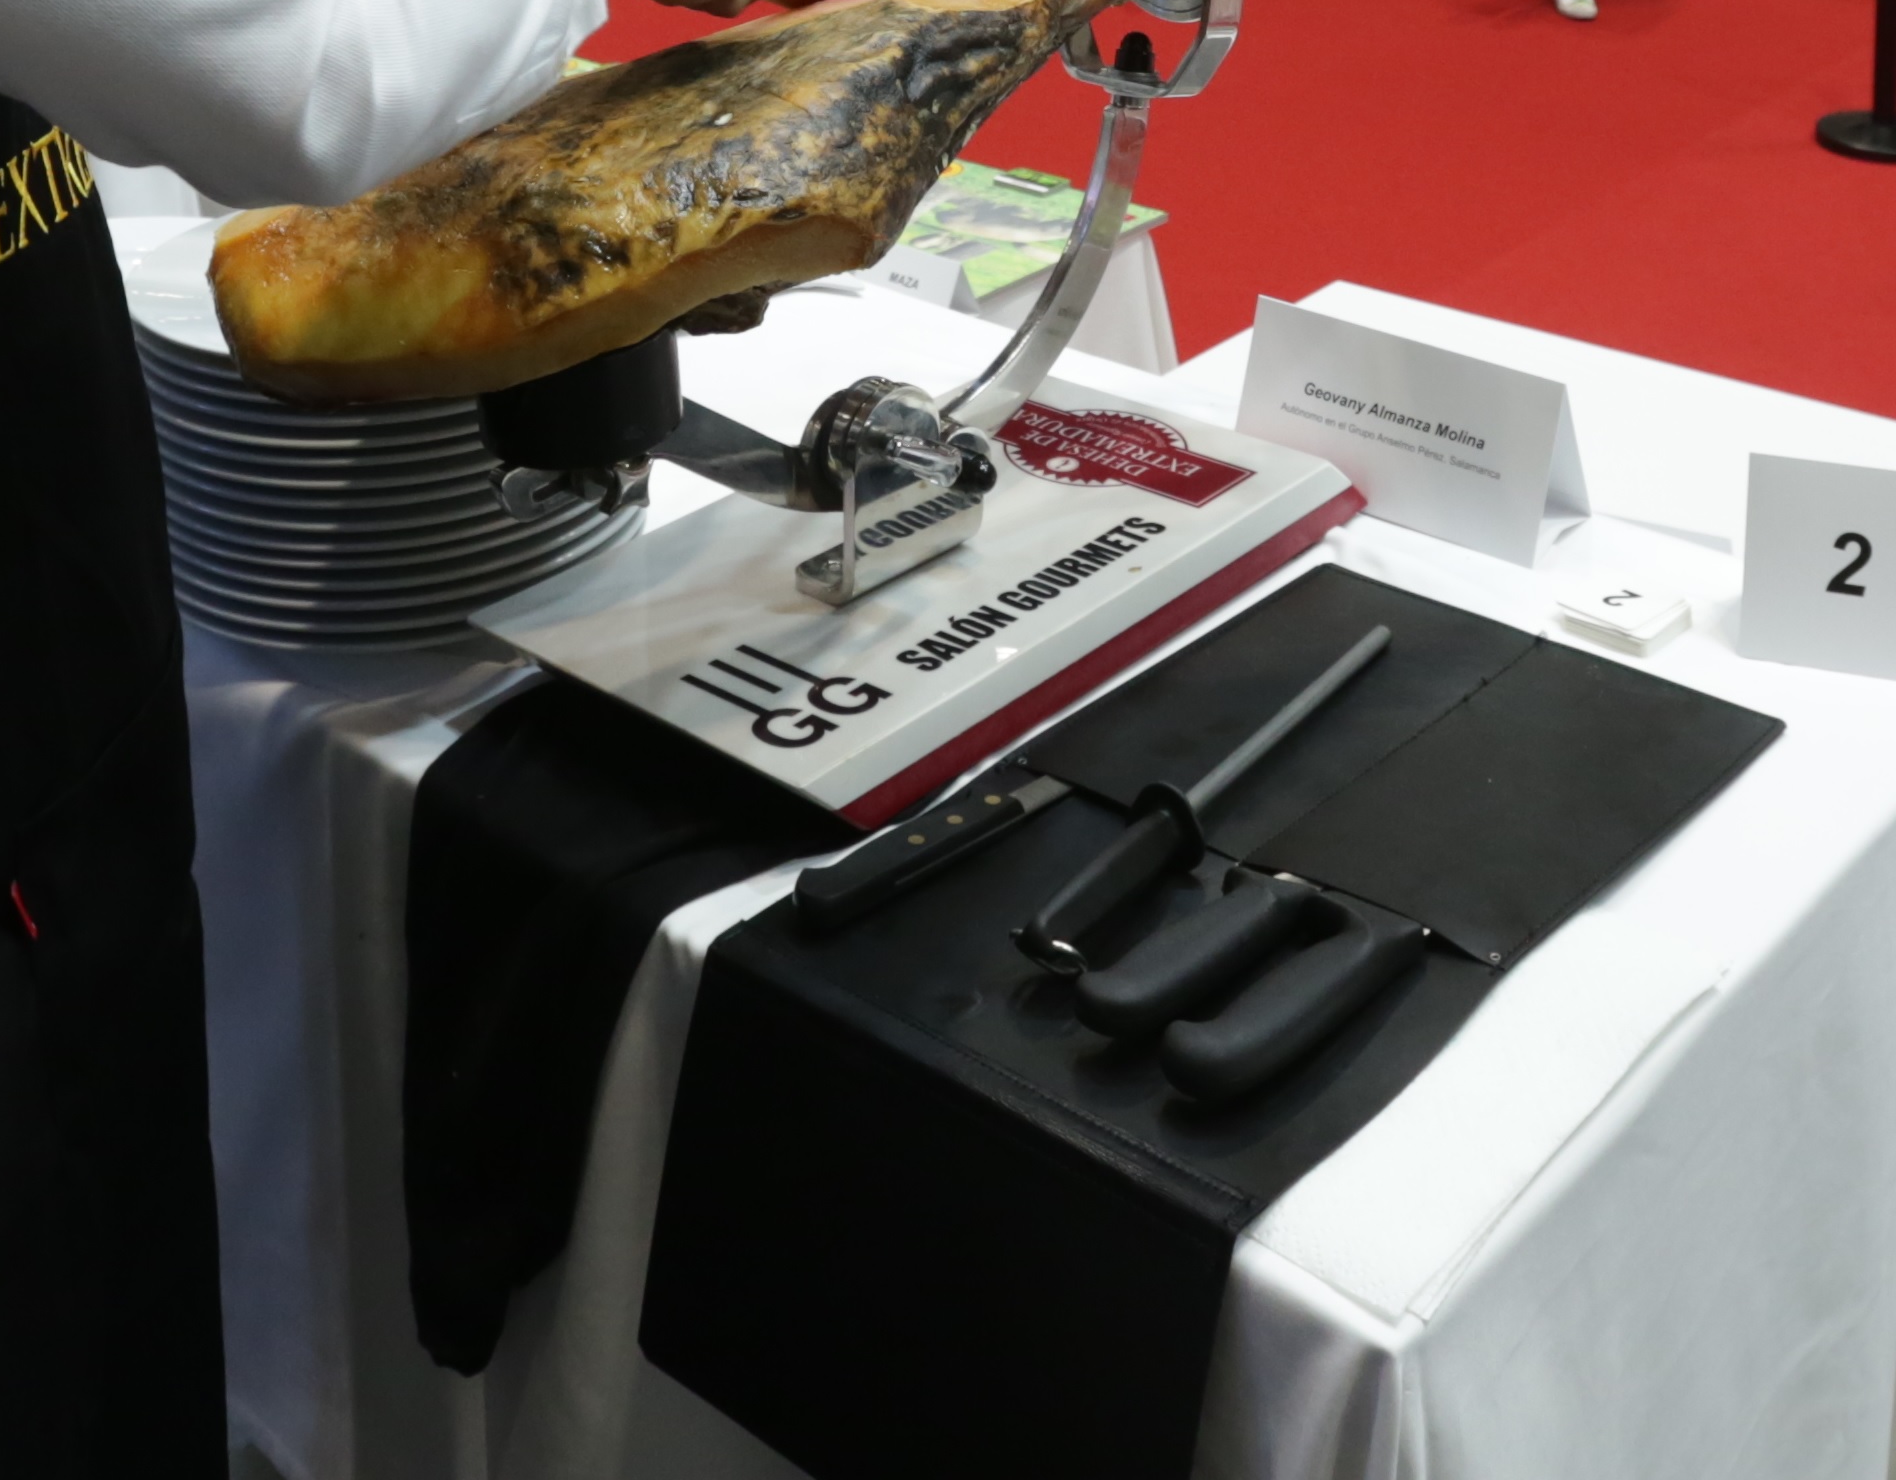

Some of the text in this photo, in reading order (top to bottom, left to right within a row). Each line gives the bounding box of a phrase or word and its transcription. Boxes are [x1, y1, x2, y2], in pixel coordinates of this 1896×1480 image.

[888, 271, 920, 291] MAZA
[1012, 409, 1203, 478] EXTREMADURA
[1304, 382, 1486, 451] Geovany Almanza Molina
[1325, 416, 1337, 428] en
[1348, 423, 1376, 441] Grupo
[1376, 432, 1416, 453] Anselmo
[1449, 455, 1502, 480] Salamanca
[1020, 429, 1151, 477] DEHESA DE
[895, 516, 1167, 673] SALÓN GOURMETS
[1825, 532, 1873, 597] 2
[1602, 589, 1643, 608] 2
